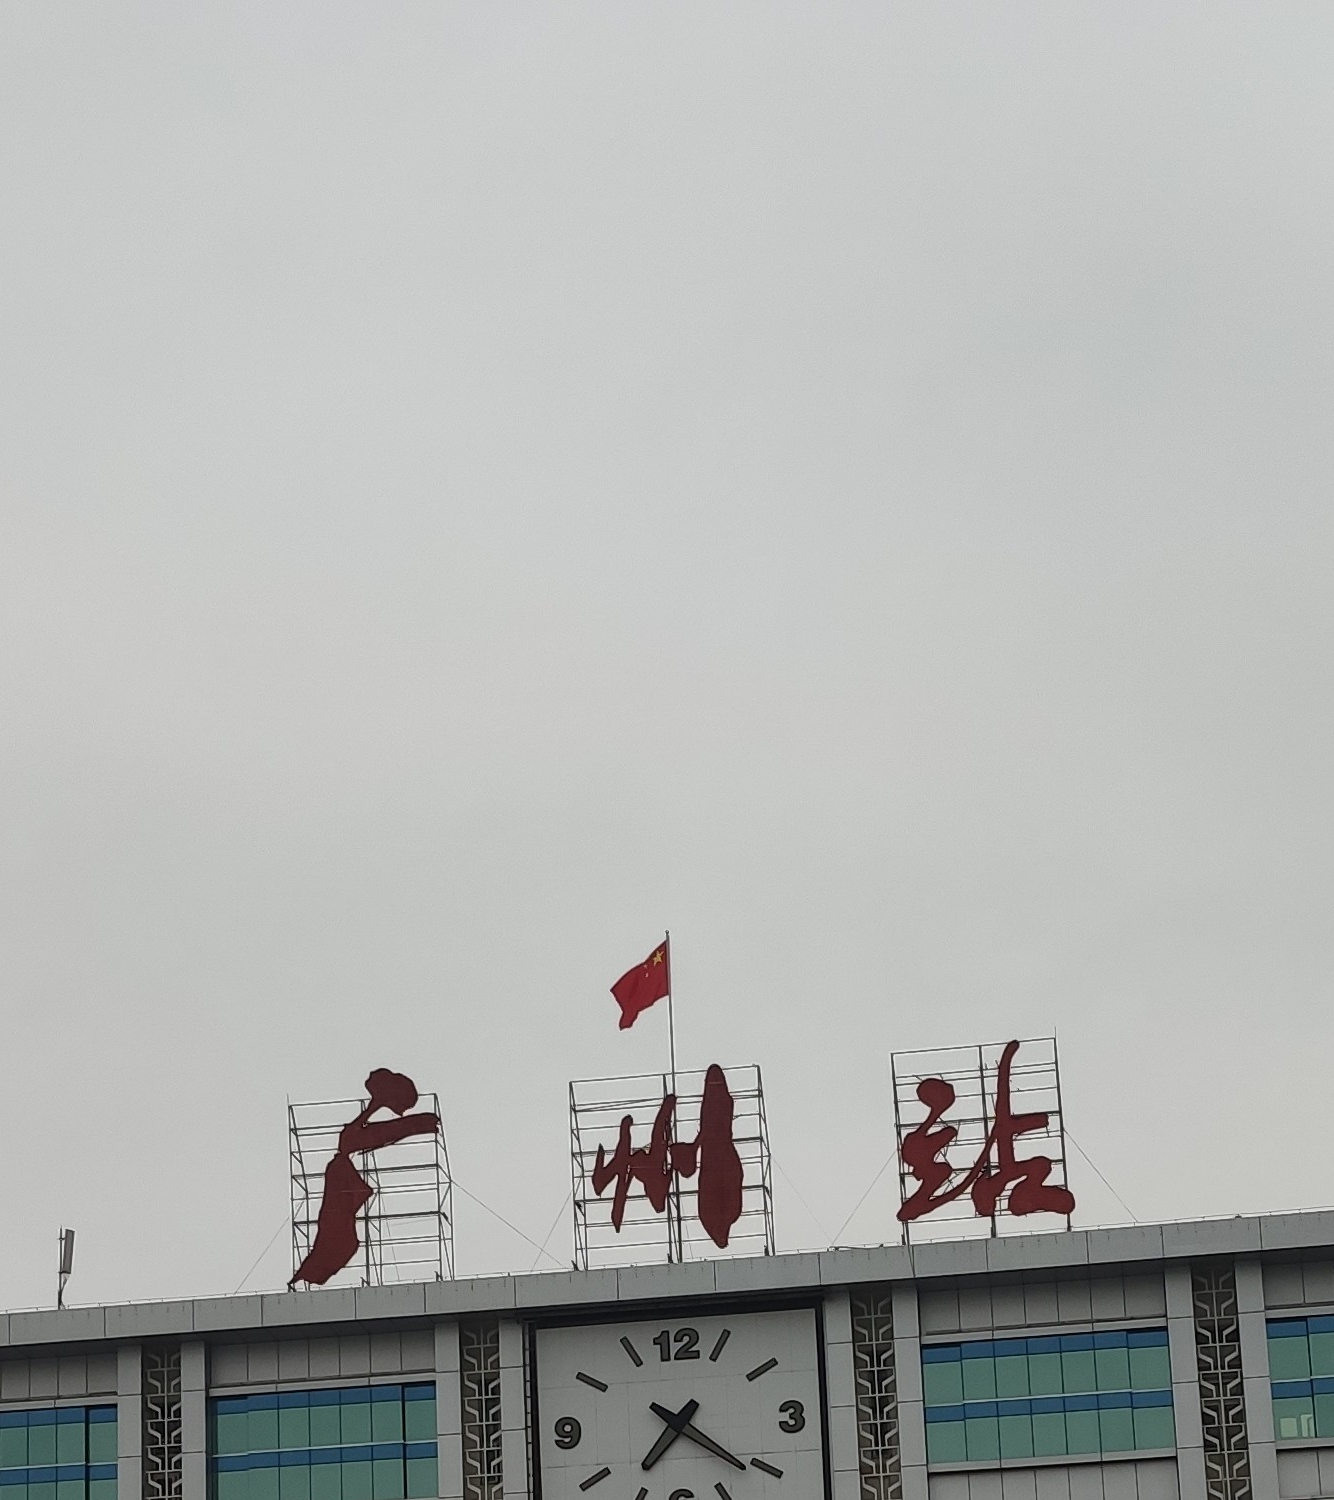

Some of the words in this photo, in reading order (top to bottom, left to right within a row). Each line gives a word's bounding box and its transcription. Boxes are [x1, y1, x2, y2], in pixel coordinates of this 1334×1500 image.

[289, 1040, 1075, 1285] 广州站
[653, 1328, 700, 1362] 12
[554, 1416, 581, 1448] 9
[778, 1401, 805, 1433] 3
